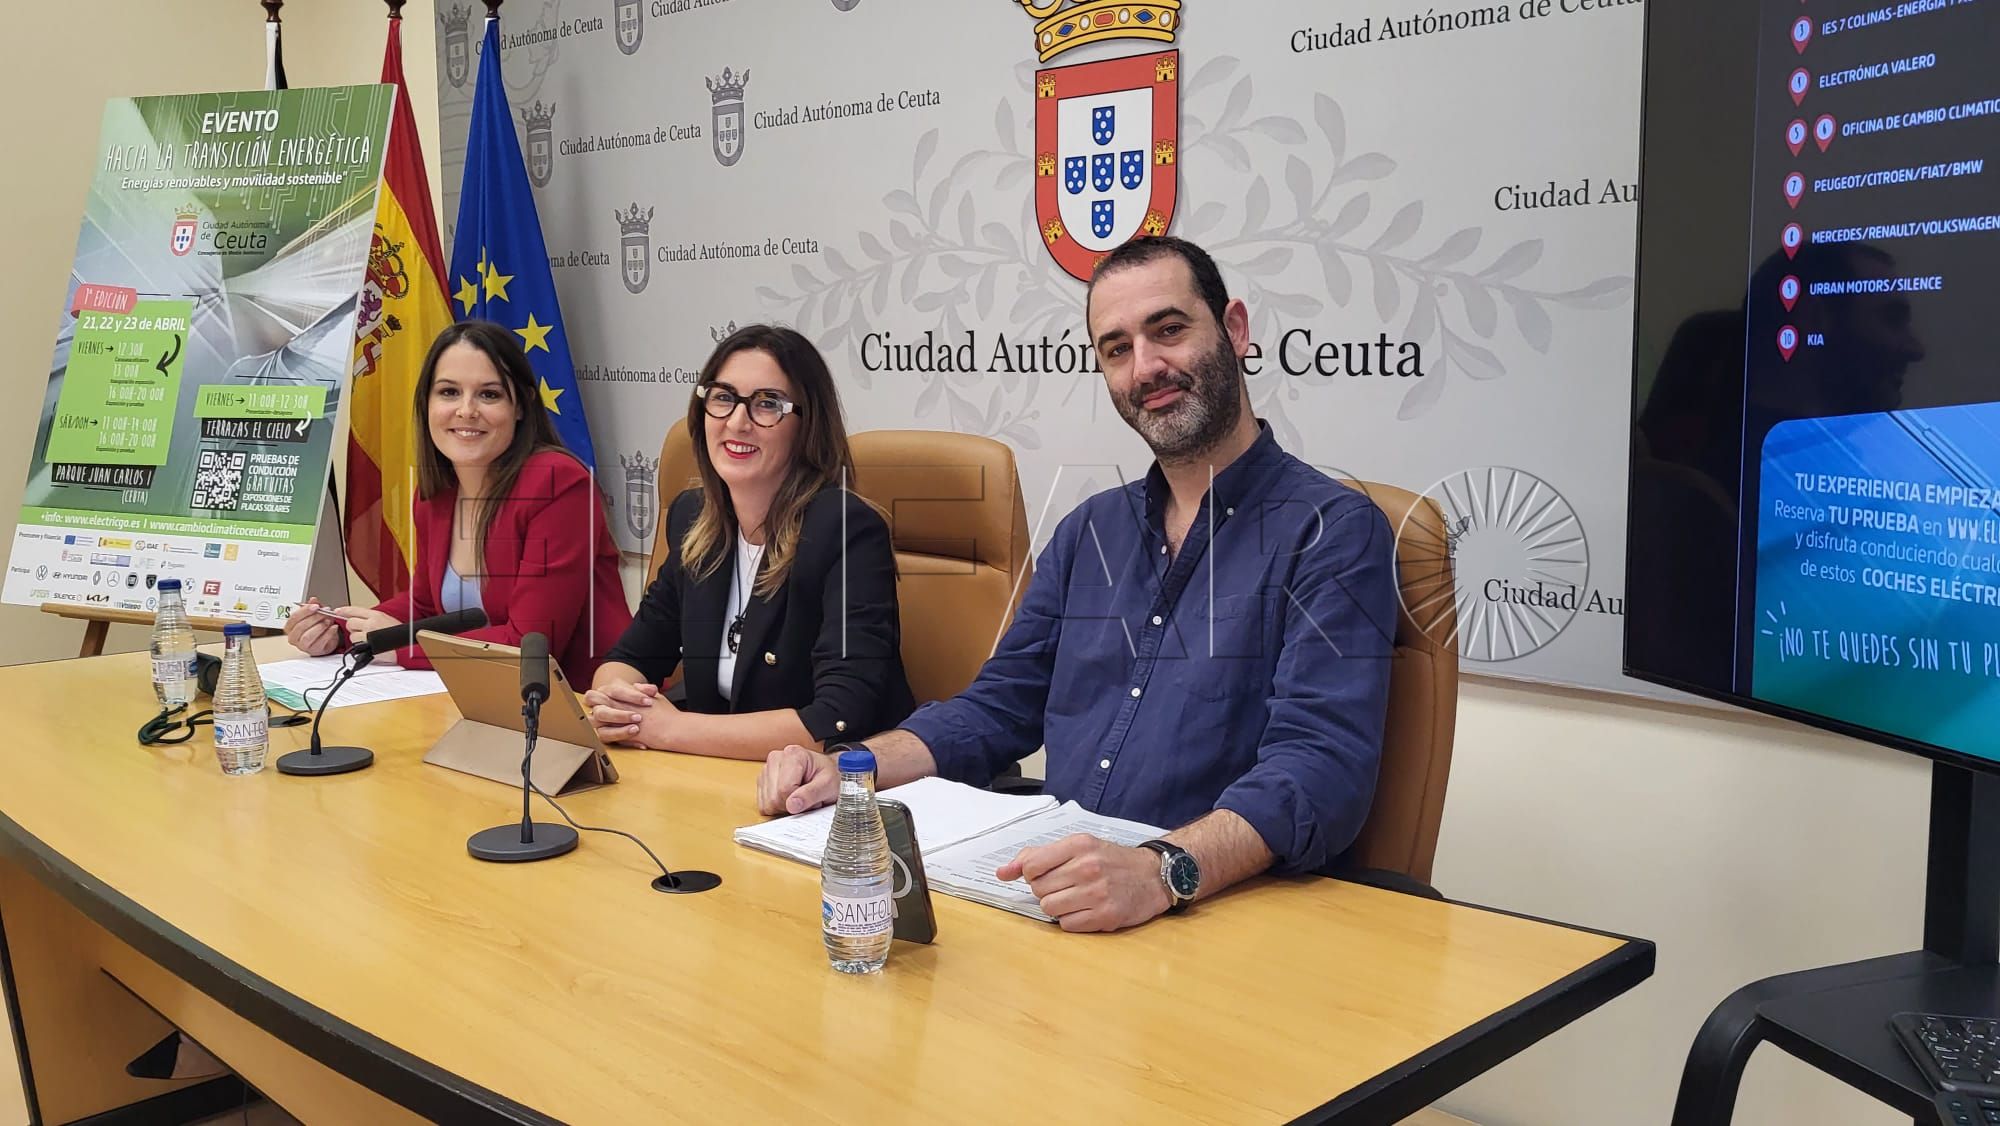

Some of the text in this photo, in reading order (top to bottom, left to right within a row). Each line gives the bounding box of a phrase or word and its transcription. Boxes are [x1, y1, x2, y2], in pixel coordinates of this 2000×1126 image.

[651, 0, 691, 18] Ciudad
[509, 29, 558, 49] Autónoma
[560, 22, 572, 38] de
[574, 16, 604, 35] Ceuta
[1290, 18, 1371, 53] Ciudad
[1378, 4, 1511, 41] Autónoma
[1519, 0, 1551, 19] de
[1822, 20, 1837, 36] IES
[1840, 18, 1846, 31] 7
[1819, 53, 1935, 88] ELECTRÓNICA VALERO
[754, 89, 941, 130] Ciudad Autónoma de Ceuta
[201, 110, 279, 134] EVENTO
[1842, 118, 1883, 137] OFICINA
[1886, 115, 1900, 130] DE
[1902, 108, 1946, 127] CAMBIO
[559, 123, 702, 156] Ciudad Autónoma de Ceuta
[105, 133, 371, 171] HACIA LA TRANSICIÓN ENERGÉTICA
[165, 174, 222, 189] renovables
[223, 177, 231, 190] y
[232, 172, 286, 186] movilidad
[1814, 160, 1983, 192] PEUGEOT/CITROEN/FIAT/BMW
[1494, 179, 1591, 211] Ciudad
[203, 220, 271, 230] Ciudad Autónoma
[1812, 215, 2000, 244] MERCEDES/RENAULT/VOLKSWAGEN
[201, 231, 267, 249] de Ceuta
[657, 237, 819, 263] Ciudad Autónoma de Ceuta
[567, 252, 580, 267] de
[581, 250, 610, 266] Ceuta
[1809, 276, 1942, 295] URBAN MOTORS/SILENCE
[94, 290, 128, 310] EDICIÓN
[114, 319, 122, 333] y
[123, 317, 137, 330] 23
[139, 317, 152, 330] de
[153, 317, 186, 331] ABRIL
[78, 341, 104, 355] VIERNES
[1807, 334, 1824, 346] KIA
[860, 328, 1425, 377] Ciudad Autón e Ceuta
[575, 365, 701, 384] udad Autónoma de Ceut
[206, 392, 234, 407] VIERNES
[206, 420, 291, 439] TERRAZAS EL CIELO
[250, 453, 300, 465] PRUEBAS DE
[56, 464, 88, 482] PARQUE
[88, 466, 112, 484] JUAN
[113, 467, 144, 486] CARLOS
[248, 464, 298, 477] CONDUCCIÓN
[246, 476, 295, 494] GRATUITAS
[1795, 472, 1814, 491] TU
[1818, 474, 1921, 502] EXPERIENCIA
[240, 503, 264, 511] PLACAS
[283, 495, 292, 503] DE
[64, 514, 140, 530] www.electricgo.es
[1775, 500, 2000, 545] Reserva TU PRUEBA en WWW.EL
[1795, 532, 1804, 550] y
[1806, 531, 1857, 554] disfruta
[1861, 540, 1957, 567] conduciendo
[1800, 559, 1817, 577] de
[1820, 564, 1856, 584] estos
[1862, 568, 1927, 595] COCHES
[1484, 578, 1577, 610] Ciudad
[1812, 630, 1831, 660] TE
[1839, 631, 1900, 666] QUEDES
[1909, 637, 1939, 671] SIN
[1948, 641, 1971, 674] TU
